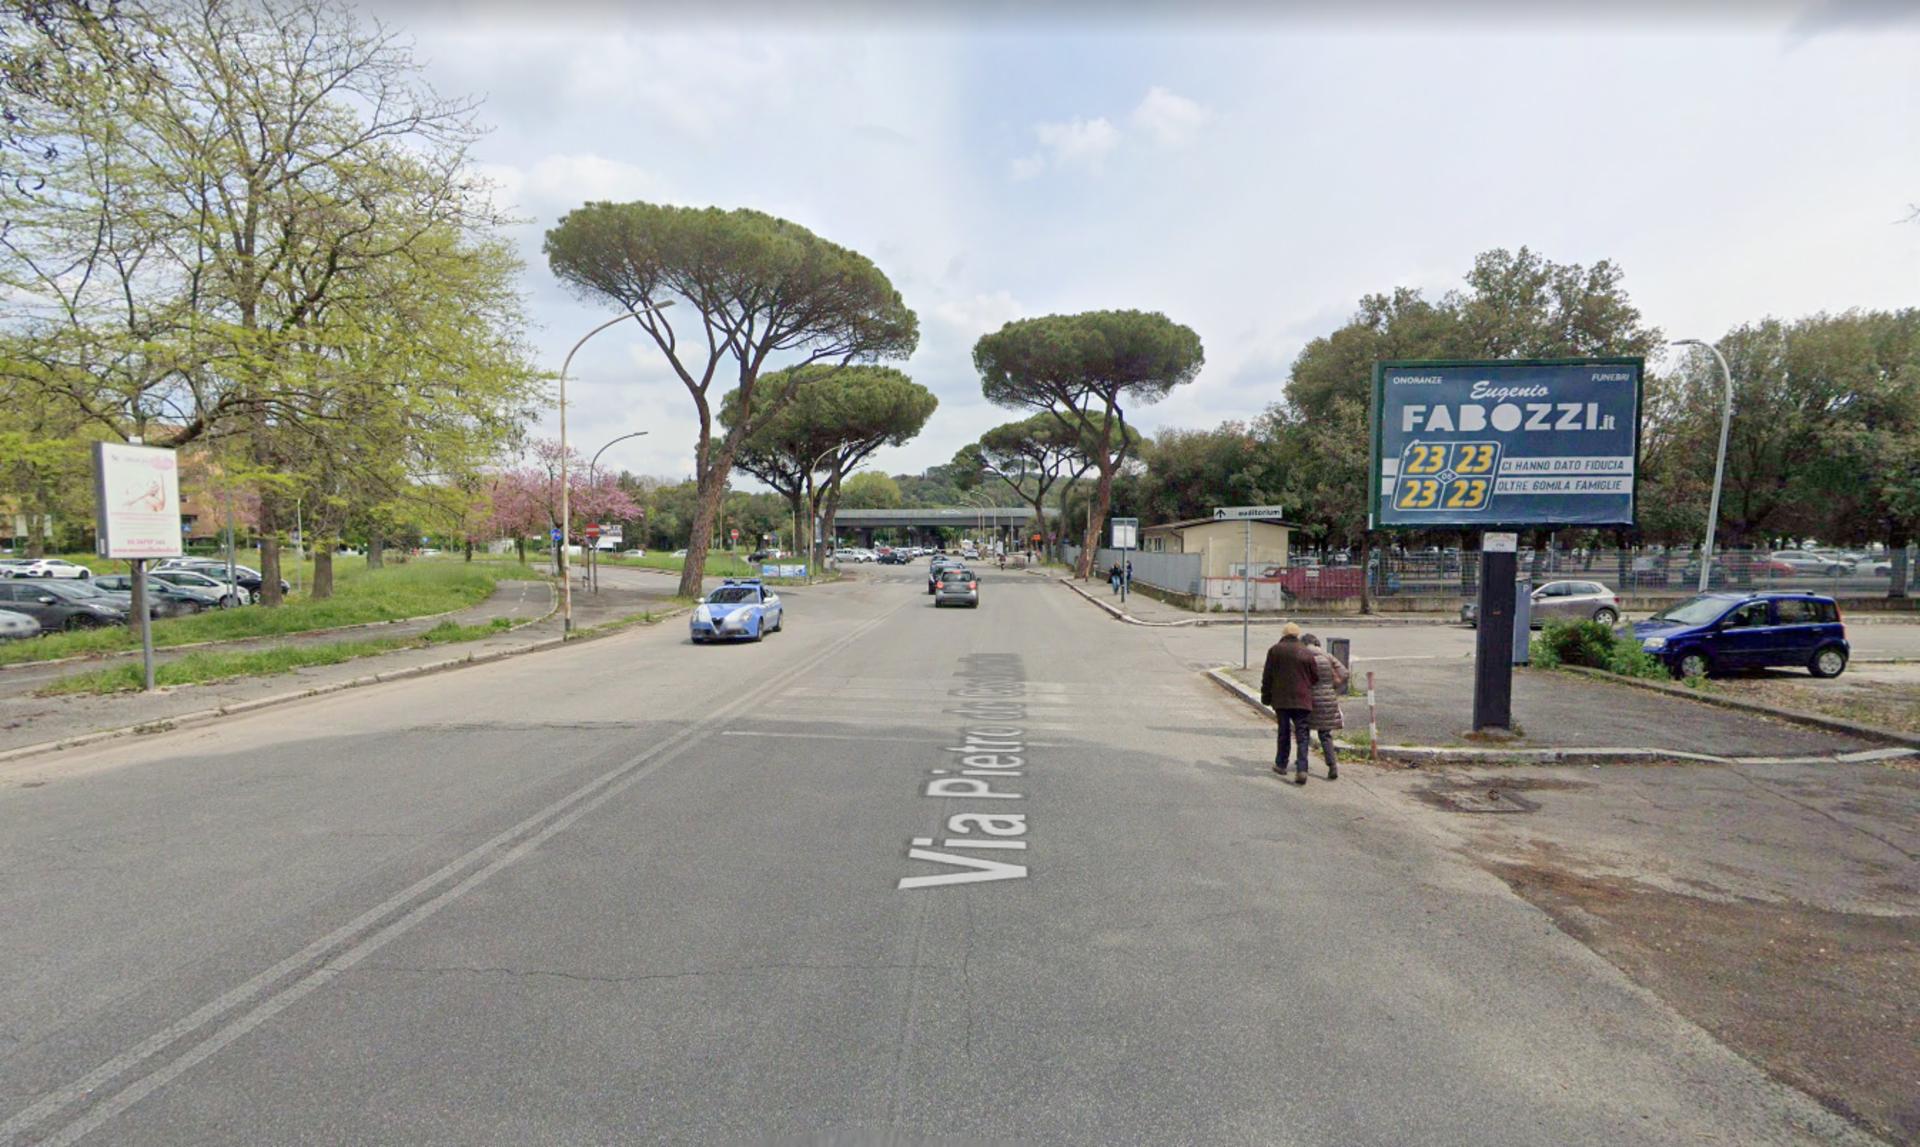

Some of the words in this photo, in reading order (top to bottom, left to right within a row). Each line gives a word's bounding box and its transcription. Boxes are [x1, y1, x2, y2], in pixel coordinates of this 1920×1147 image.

[1393, 376, 1442, 385] ONORANZE
[1592, 373, 1629, 382] FUNEBRI
[1470, 381, 1549, 403] Eugenio
[1408, 445, 1446, 473] 23
[1456, 445, 1494, 473] 23
[1501, 461, 1511, 471] CI
[1515, 460, 1551, 470] HANNO
[1554, 460, 1581, 470] DATO
[1585, 460, 1624, 470] FIDUCIA
[1497, 480, 1528, 491] OLTRE
[1575, 480, 1623, 490] FAMIGLIE
[1400, 480, 1438, 507] 23
[1447, 480, 1486, 507] 23
